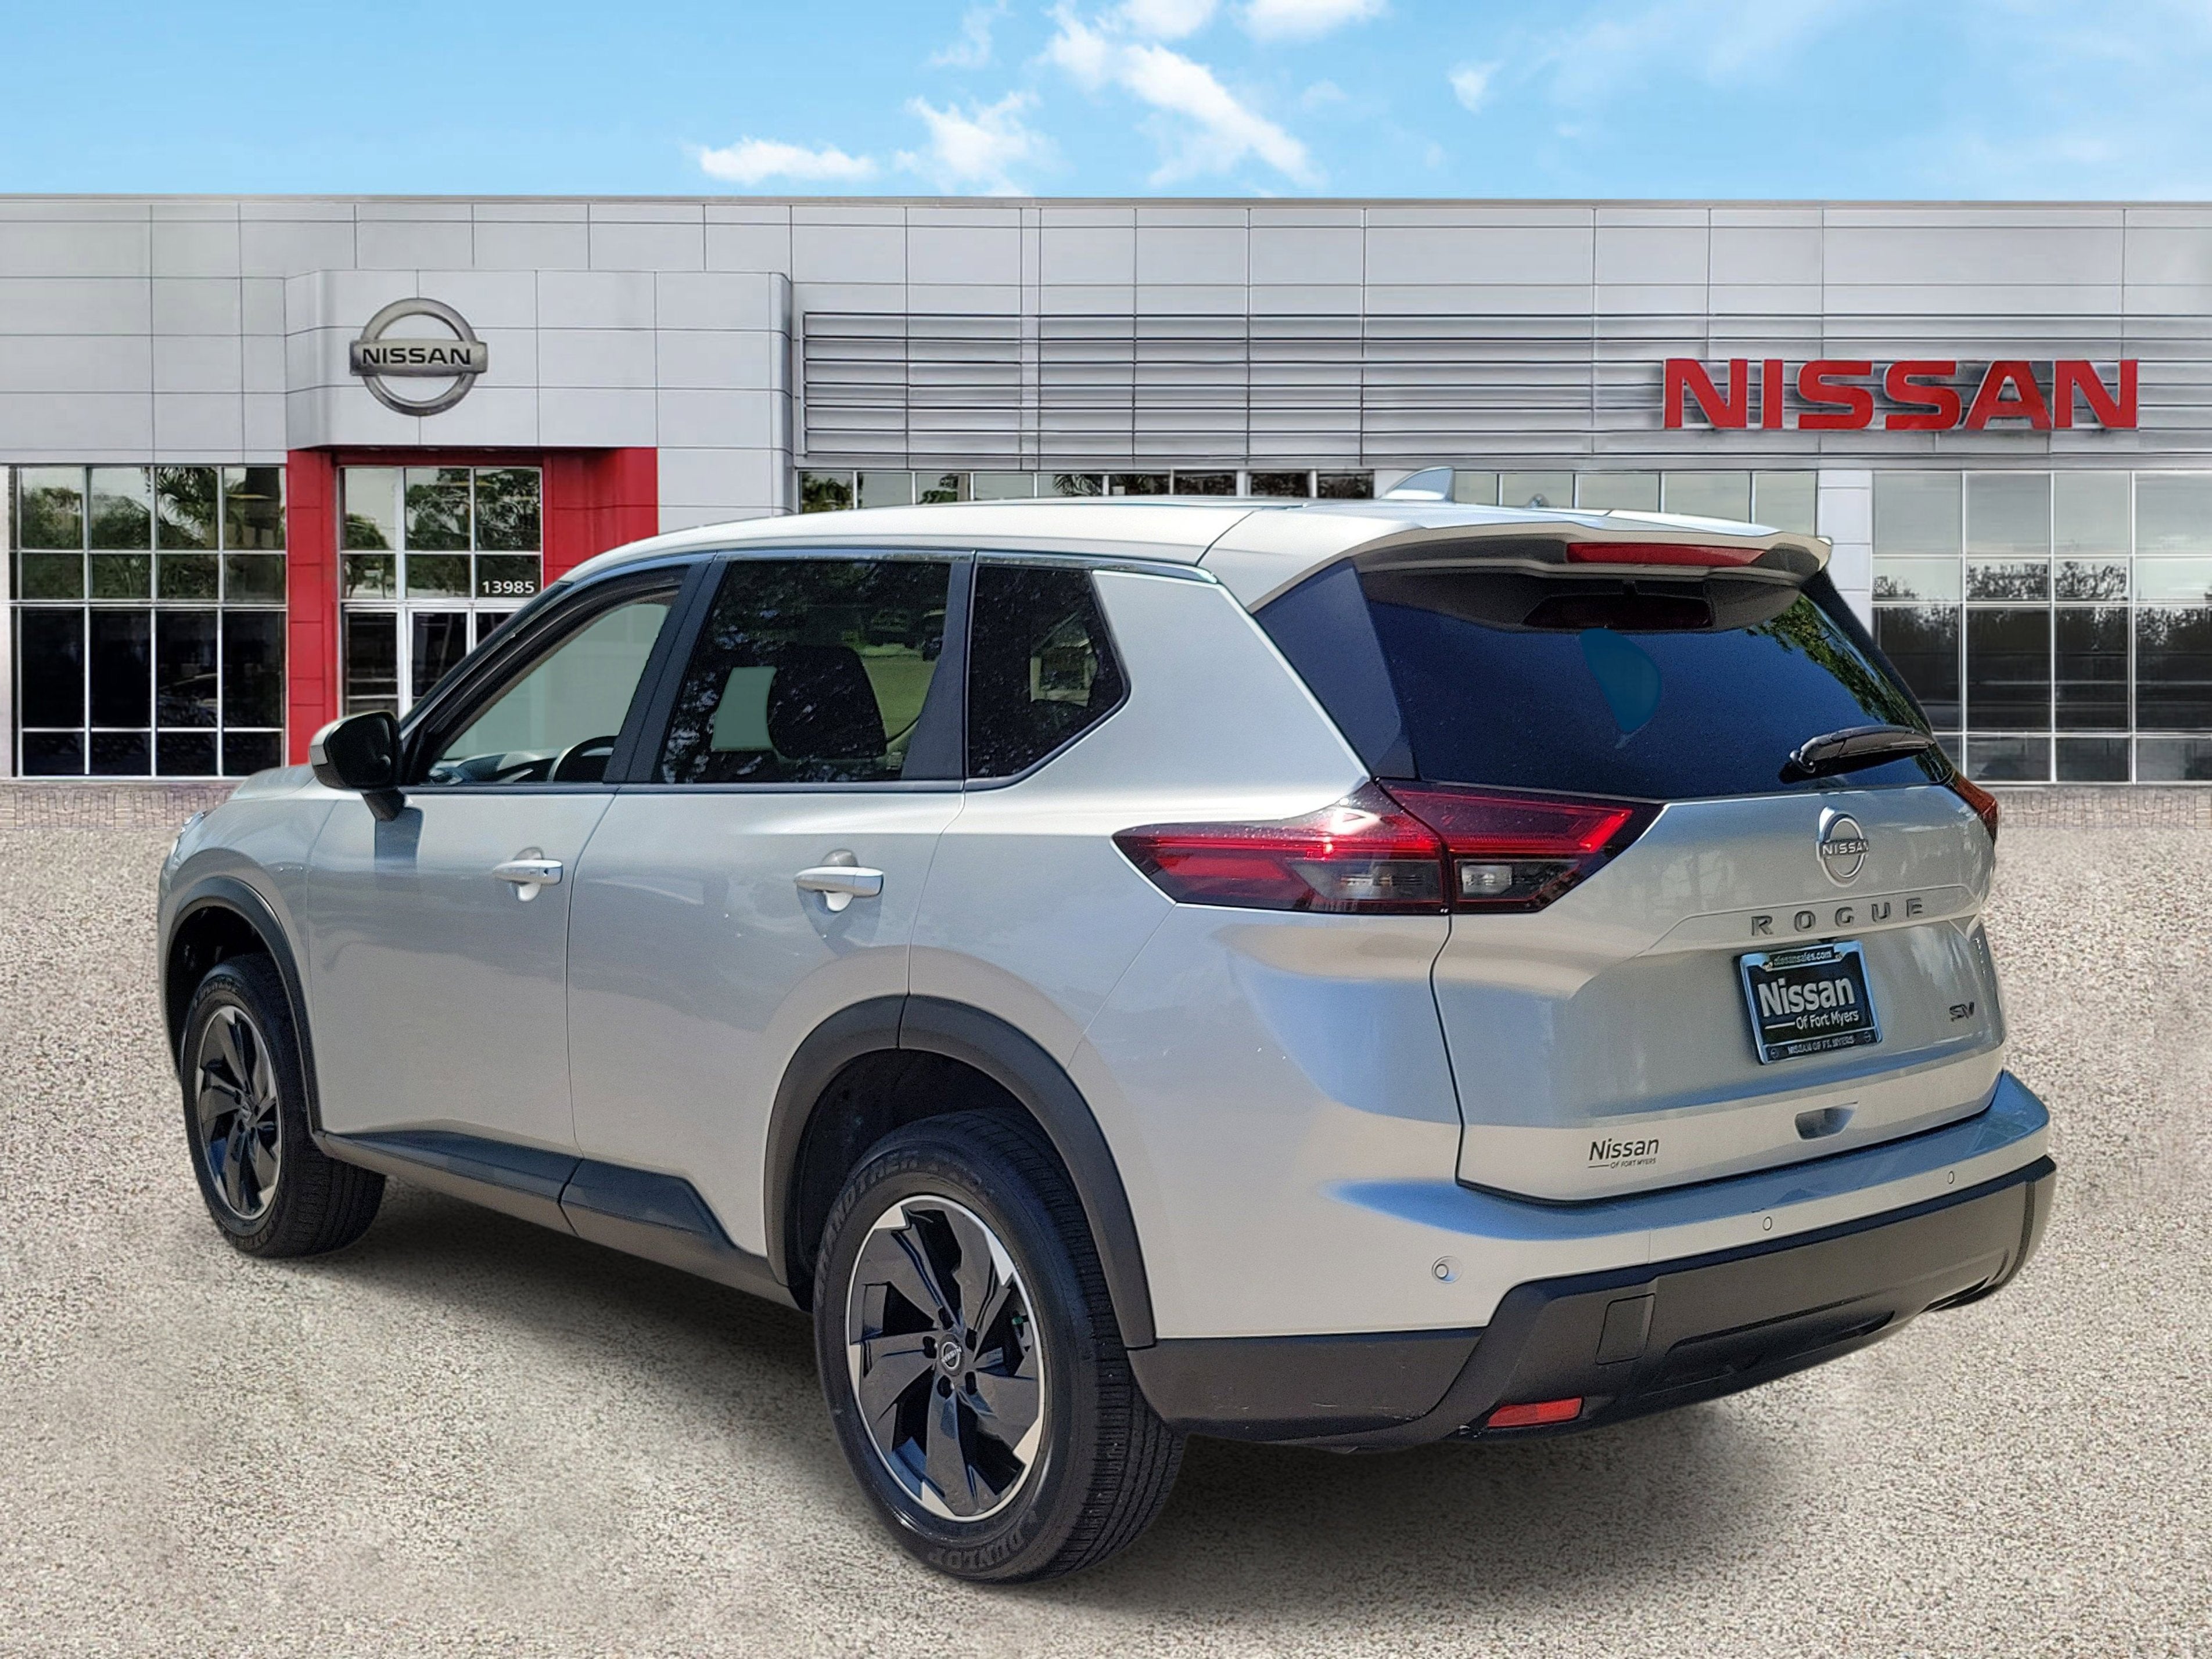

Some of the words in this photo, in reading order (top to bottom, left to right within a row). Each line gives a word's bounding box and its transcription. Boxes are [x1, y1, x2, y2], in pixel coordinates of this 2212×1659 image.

[362, 348, 472, 365] NISSAN
[1664, 358, 2139, 430] NISSAN
[482, 581, 534, 594] 13985
[1822, 841, 1869, 855] NISSAN
[1750, 898, 1923, 936] ROGUE
[1758, 978, 1855, 1017] Nissan
[1796, 1016, 1808, 1030] Of
[1810, 1013, 1830, 1028] Fort
[1830, 1010, 1859, 1026] Myers
[1949, 1002, 1974, 1021] SV
[1787, 1042, 1812, 1055] NISSAN
[1589, 1138, 1659, 1161] Nissan
[1610, 1161, 1620, 1169] OF
[1621, 1159, 1636, 1168] FORT
